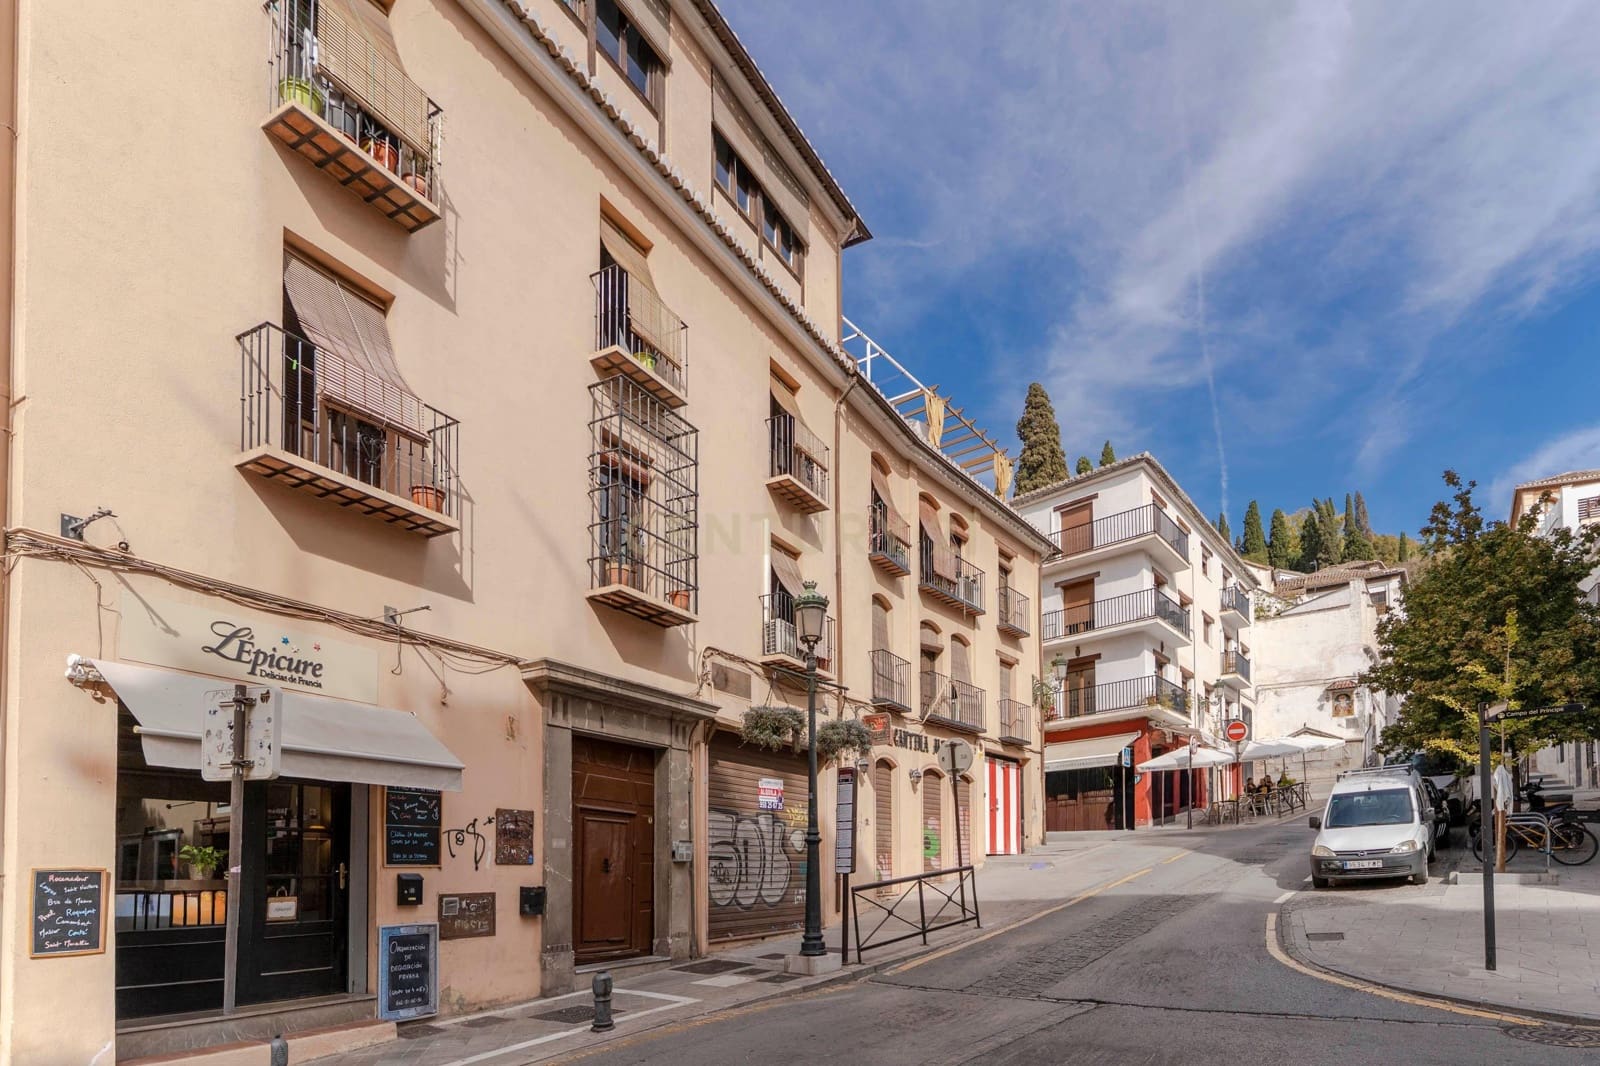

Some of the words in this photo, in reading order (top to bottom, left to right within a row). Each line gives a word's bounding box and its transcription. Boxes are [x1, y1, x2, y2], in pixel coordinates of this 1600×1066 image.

[259, 668, 287, 682] Delicias
[288, 675, 297, 684] de
[298, 677, 322, 688] Francia
[1506, 711, 1527, 719] Campo
